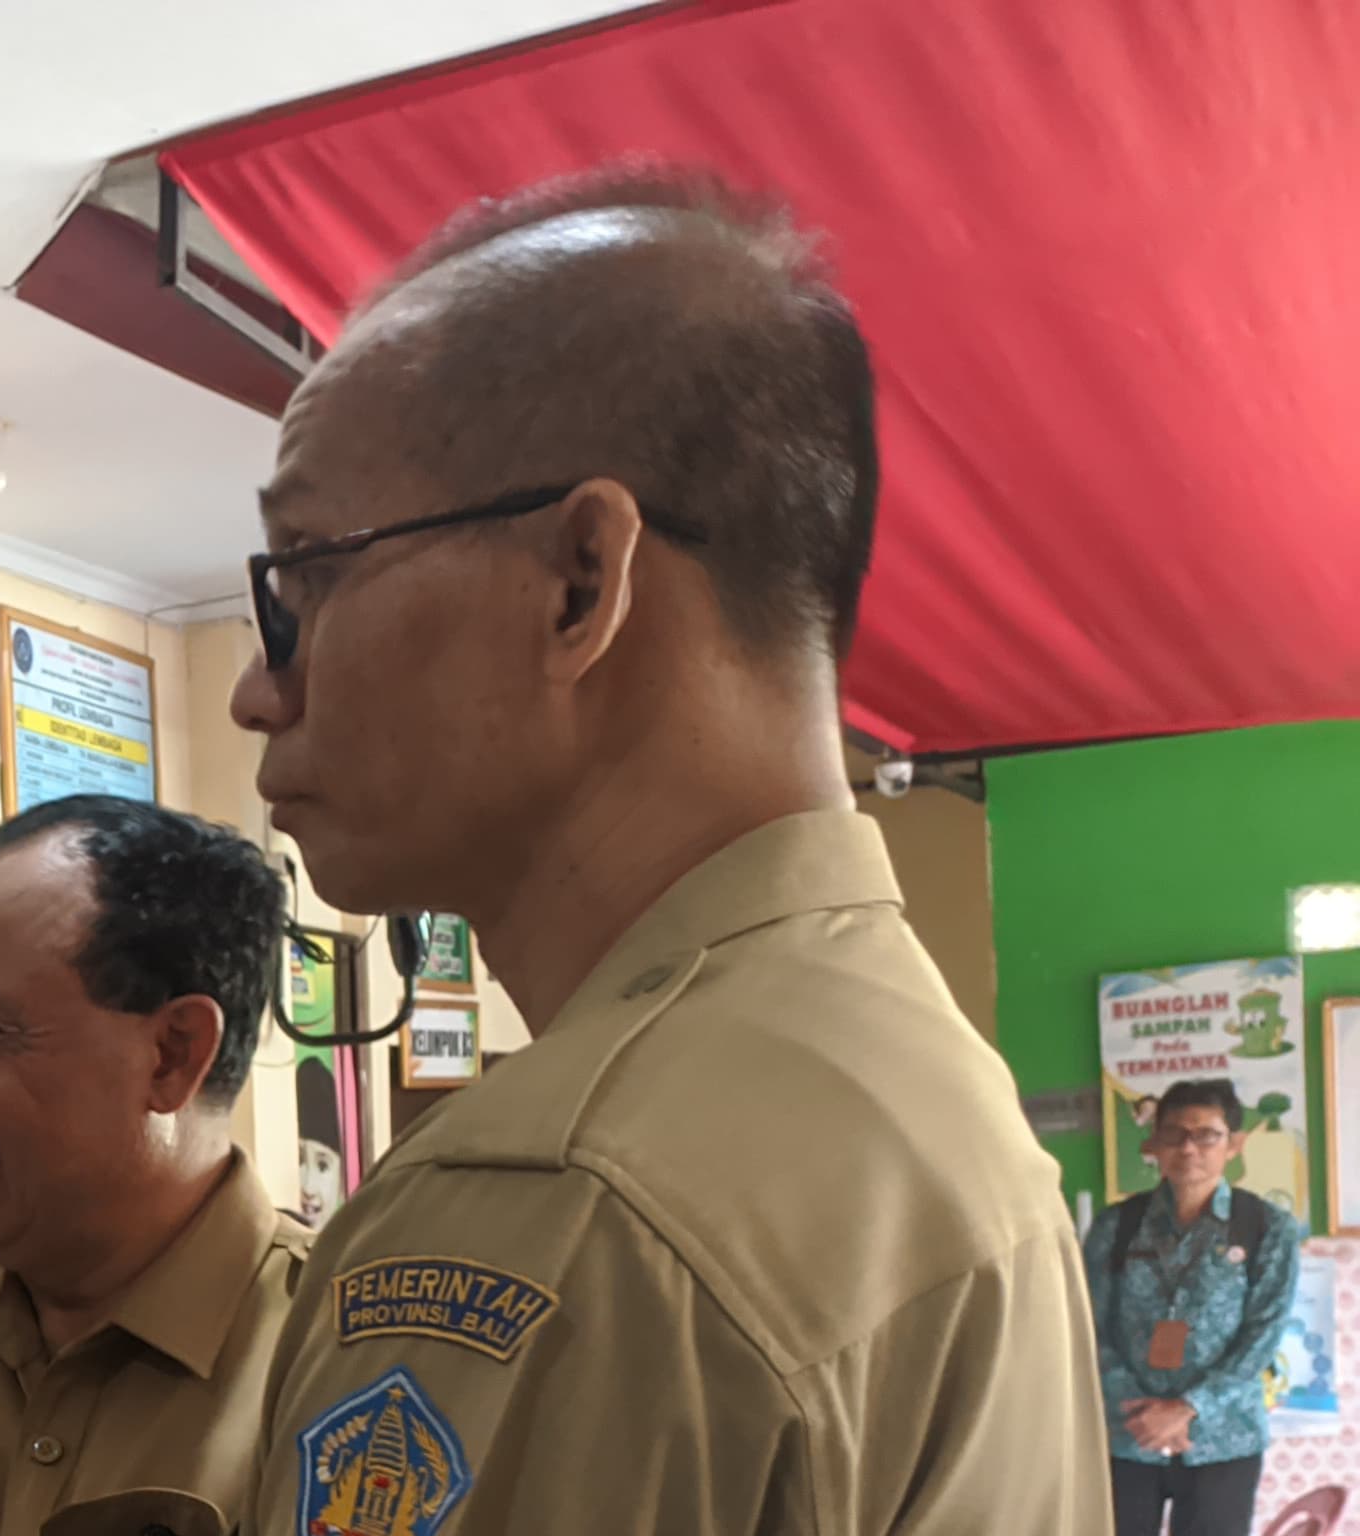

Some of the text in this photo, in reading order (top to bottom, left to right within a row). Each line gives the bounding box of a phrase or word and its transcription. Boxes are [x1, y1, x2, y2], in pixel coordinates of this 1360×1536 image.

[1113, 992, 1229, 1021] BUANGLAH
[1131, 1017, 1211, 1039] SAMPAH
[1117, 1054, 1230, 1077] TEMPATNYA
[345, 1268, 544, 1327] PEMERINTAH
[349, 1303, 450, 1327] PROVINSI
